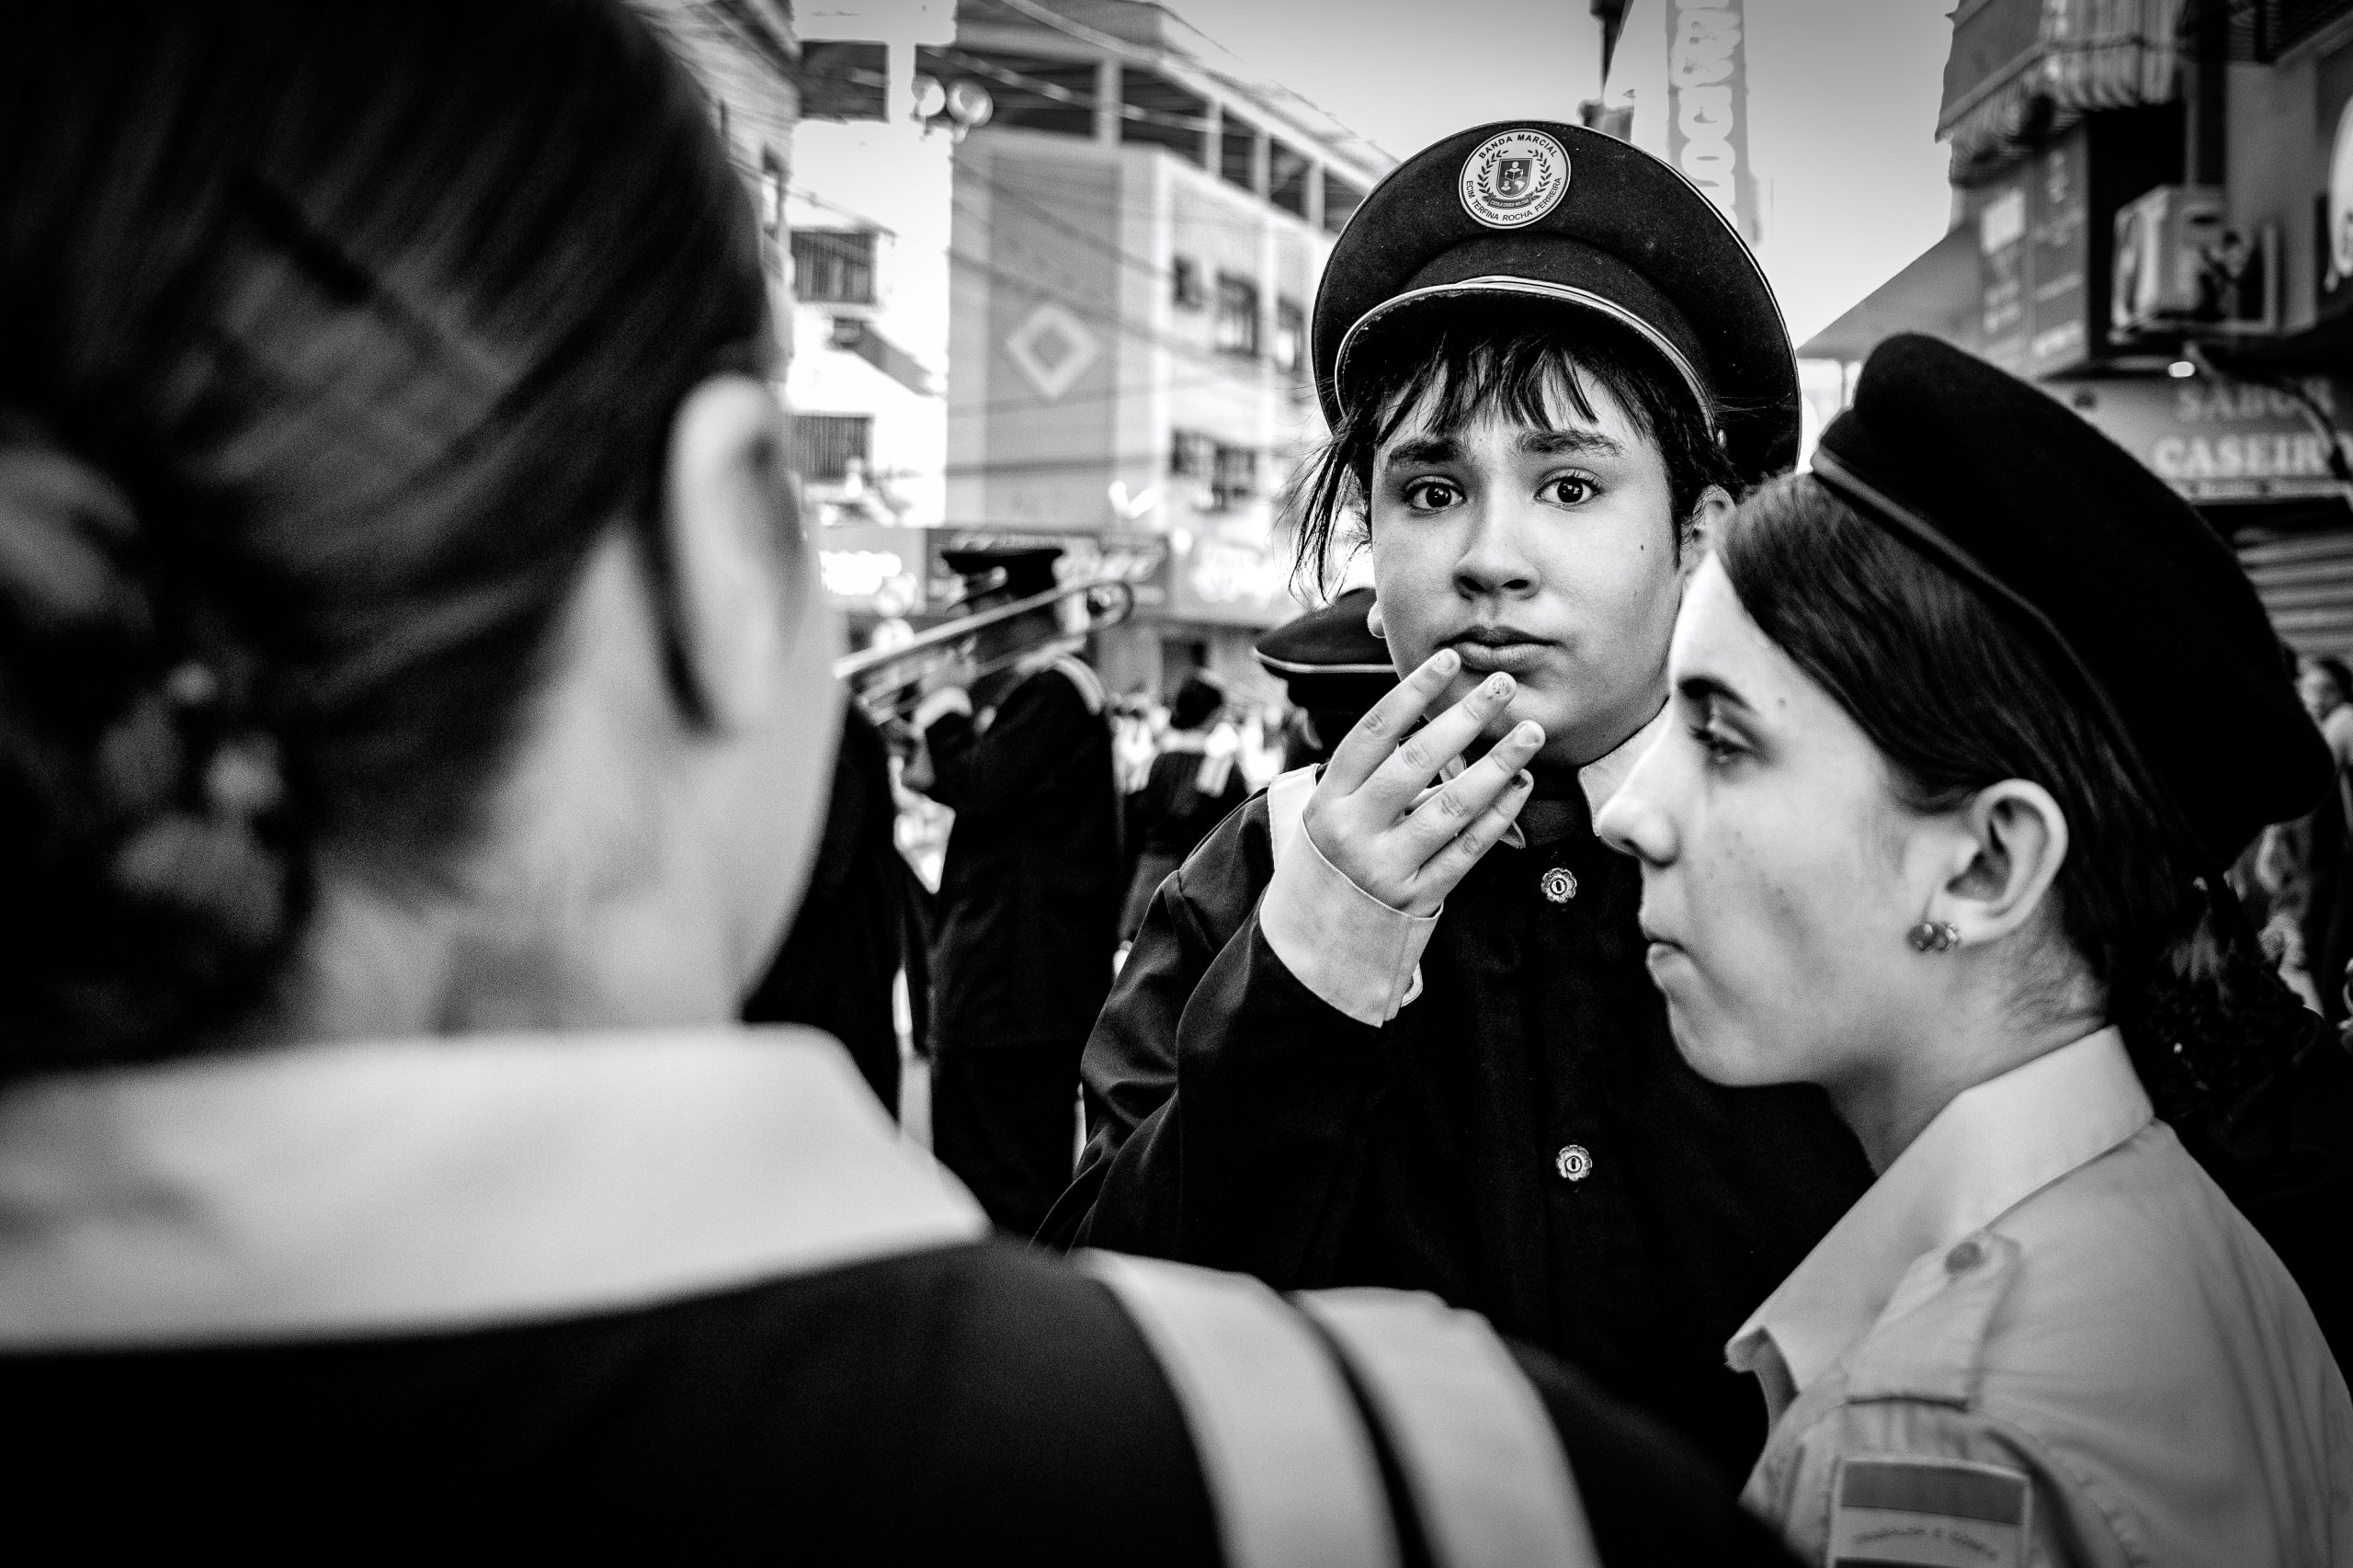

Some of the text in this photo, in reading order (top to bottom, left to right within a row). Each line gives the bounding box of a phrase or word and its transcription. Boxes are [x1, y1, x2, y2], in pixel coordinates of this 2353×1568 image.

[1479, 134, 1557, 159] BANDA MARCIAL
[1466, 180, 1475, 199] ECIM
[1472, 199, 1499, 221] TERFINA
[1502, 210, 1533, 222] ROCHA
[1534, 177, 1562, 212] FERREIRA
